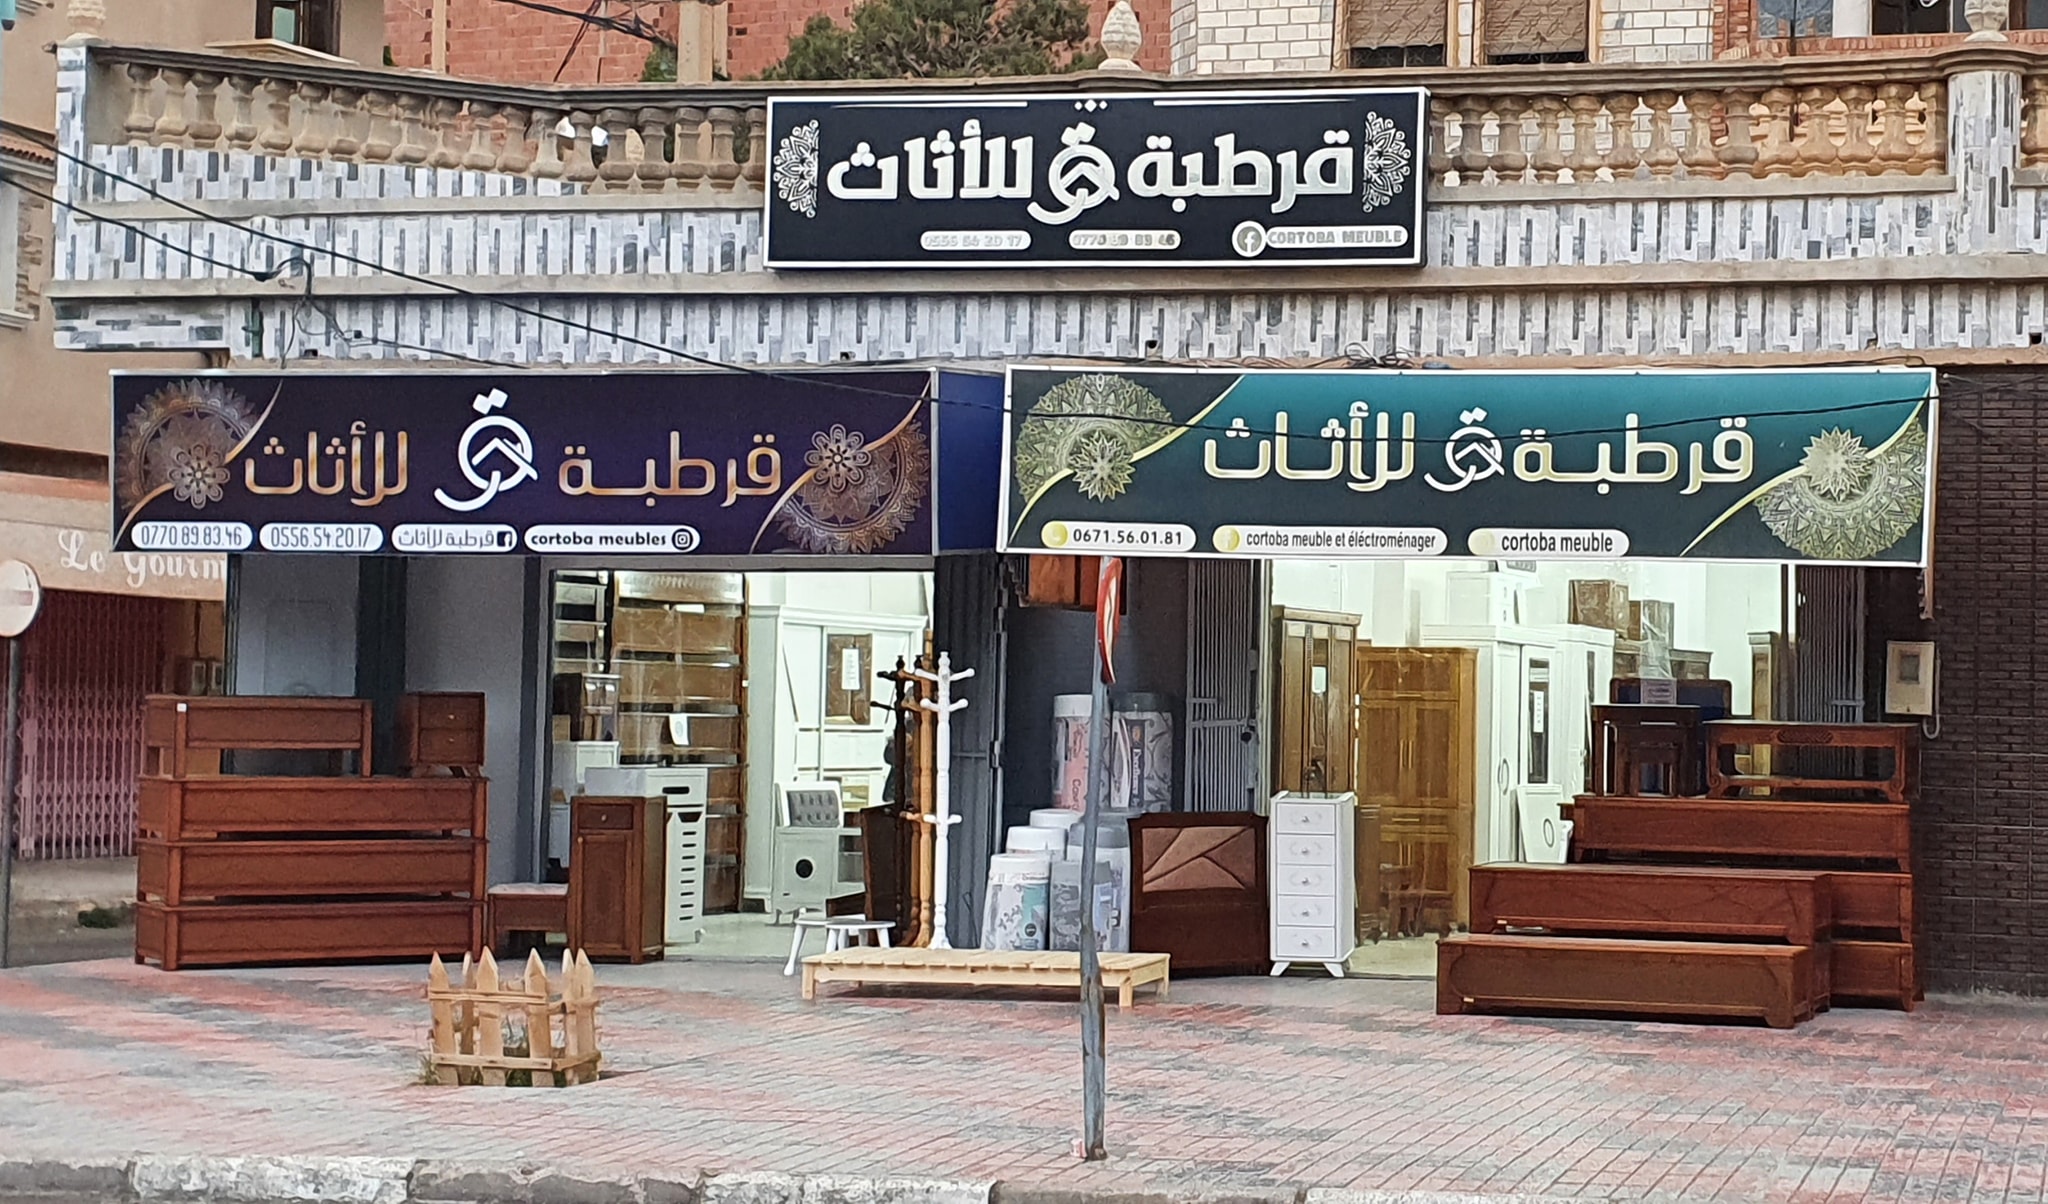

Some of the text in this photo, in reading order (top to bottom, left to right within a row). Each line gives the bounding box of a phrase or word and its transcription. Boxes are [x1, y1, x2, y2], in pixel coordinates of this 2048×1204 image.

[826, 118, 1034, 200] للأثاث
[1127, 130, 1353, 214] قرطبة
[1268, 230, 1403, 244] CORTOBA MEUBLE
[1204, 401, 1415, 492] للأثاث
[1513, 413, 1754, 495] قرطبة
[245, 420, 408, 507] للأثاث
[558, 430, 782, 508] قرطبة
[141, 525, 243, 547] 0770.89.83.46
[271, 526, 371, 548] 0556.54.20.17
[398, 526, 494, 549] قرطبة للأثاث
[531, 531, 666, 546] cortoba meubles
[1073, 528, 1182, 545] 0671.56.01.81
[1246, 530, 1436, 551] cortoba meuble et éléctroménager
[1501, 531, 1613, 552] cortoba meuble
[58, 531, 105, 573] Le
